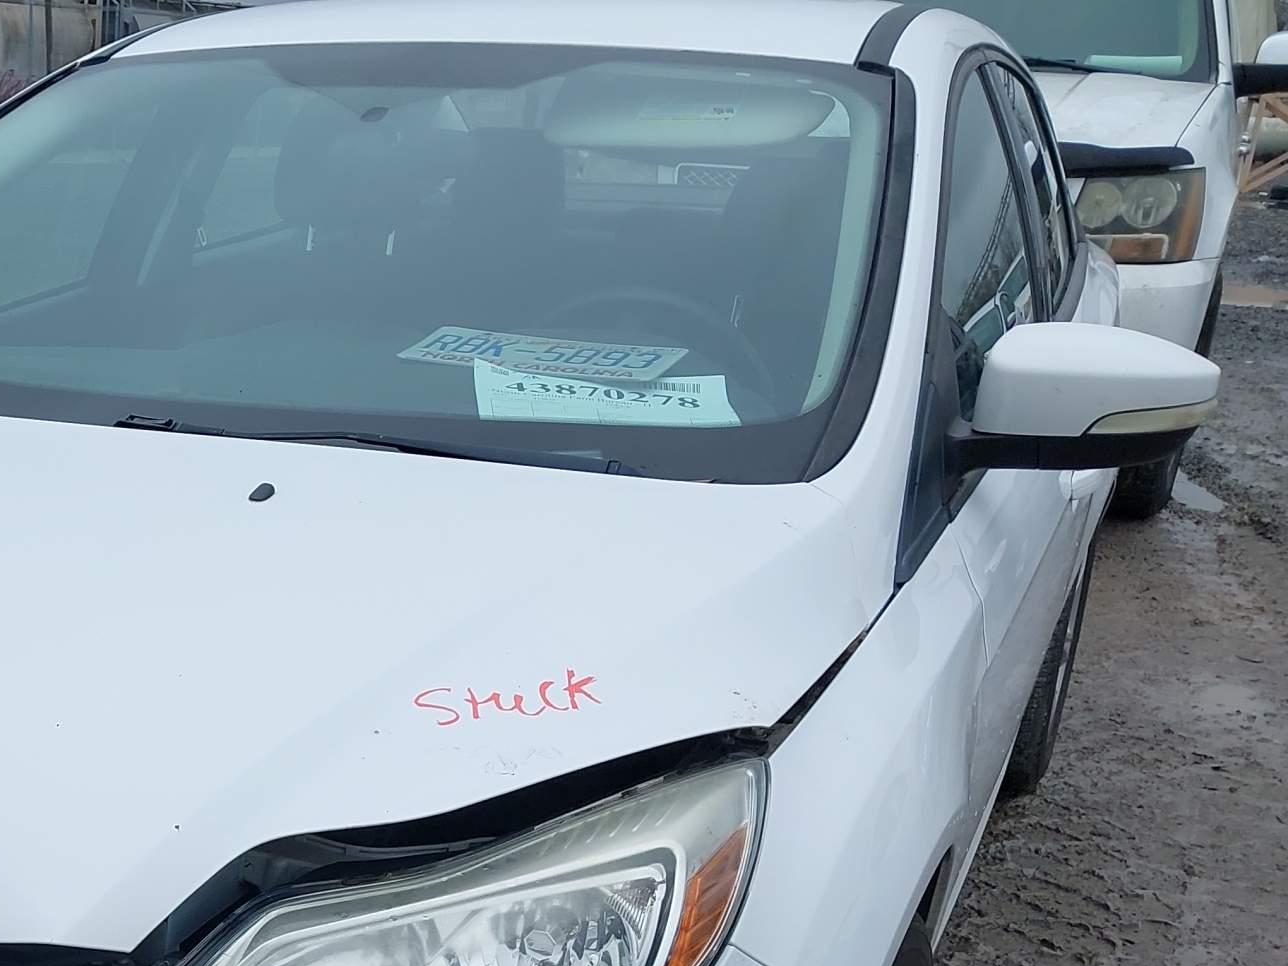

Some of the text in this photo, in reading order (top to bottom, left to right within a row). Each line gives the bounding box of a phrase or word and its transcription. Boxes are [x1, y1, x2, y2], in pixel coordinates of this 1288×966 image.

[423, 333, 662, 369] RBK-5893
[512, 362, 633, 378] CAROLINA
[504, 380, 701, 409] 43870278
